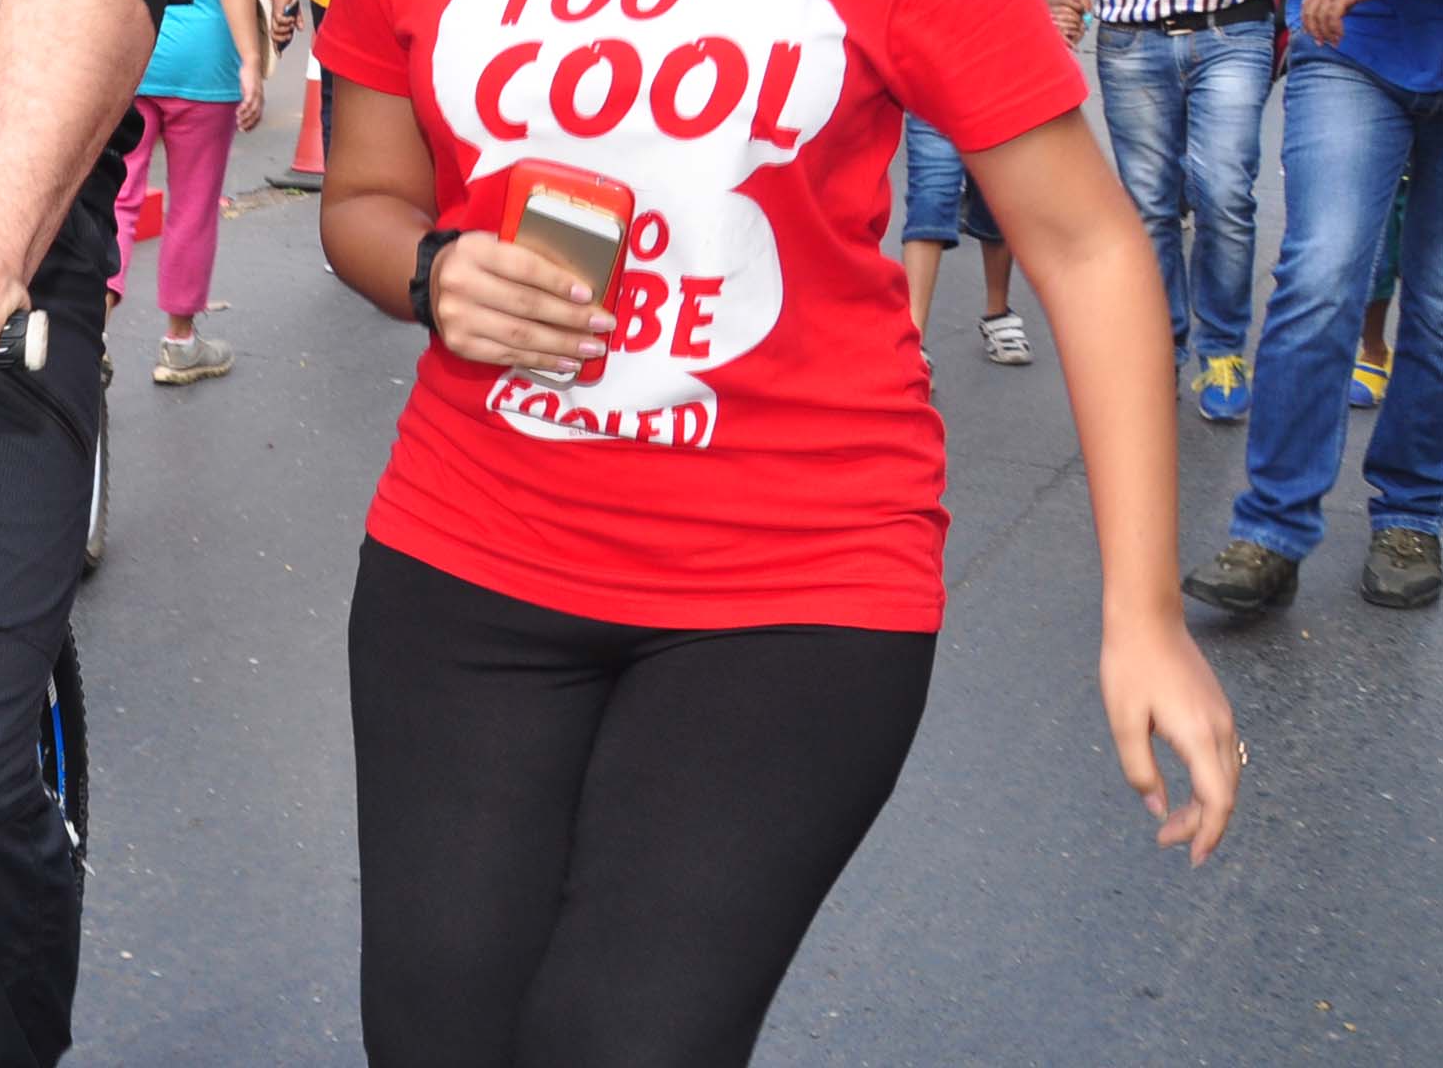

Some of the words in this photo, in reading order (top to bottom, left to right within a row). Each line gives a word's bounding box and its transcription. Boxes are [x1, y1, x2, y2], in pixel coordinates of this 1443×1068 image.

[474, 36, 802, 150] COOL
[629, 209, 670, 262] O
[609, 269, 725, 358] BE
